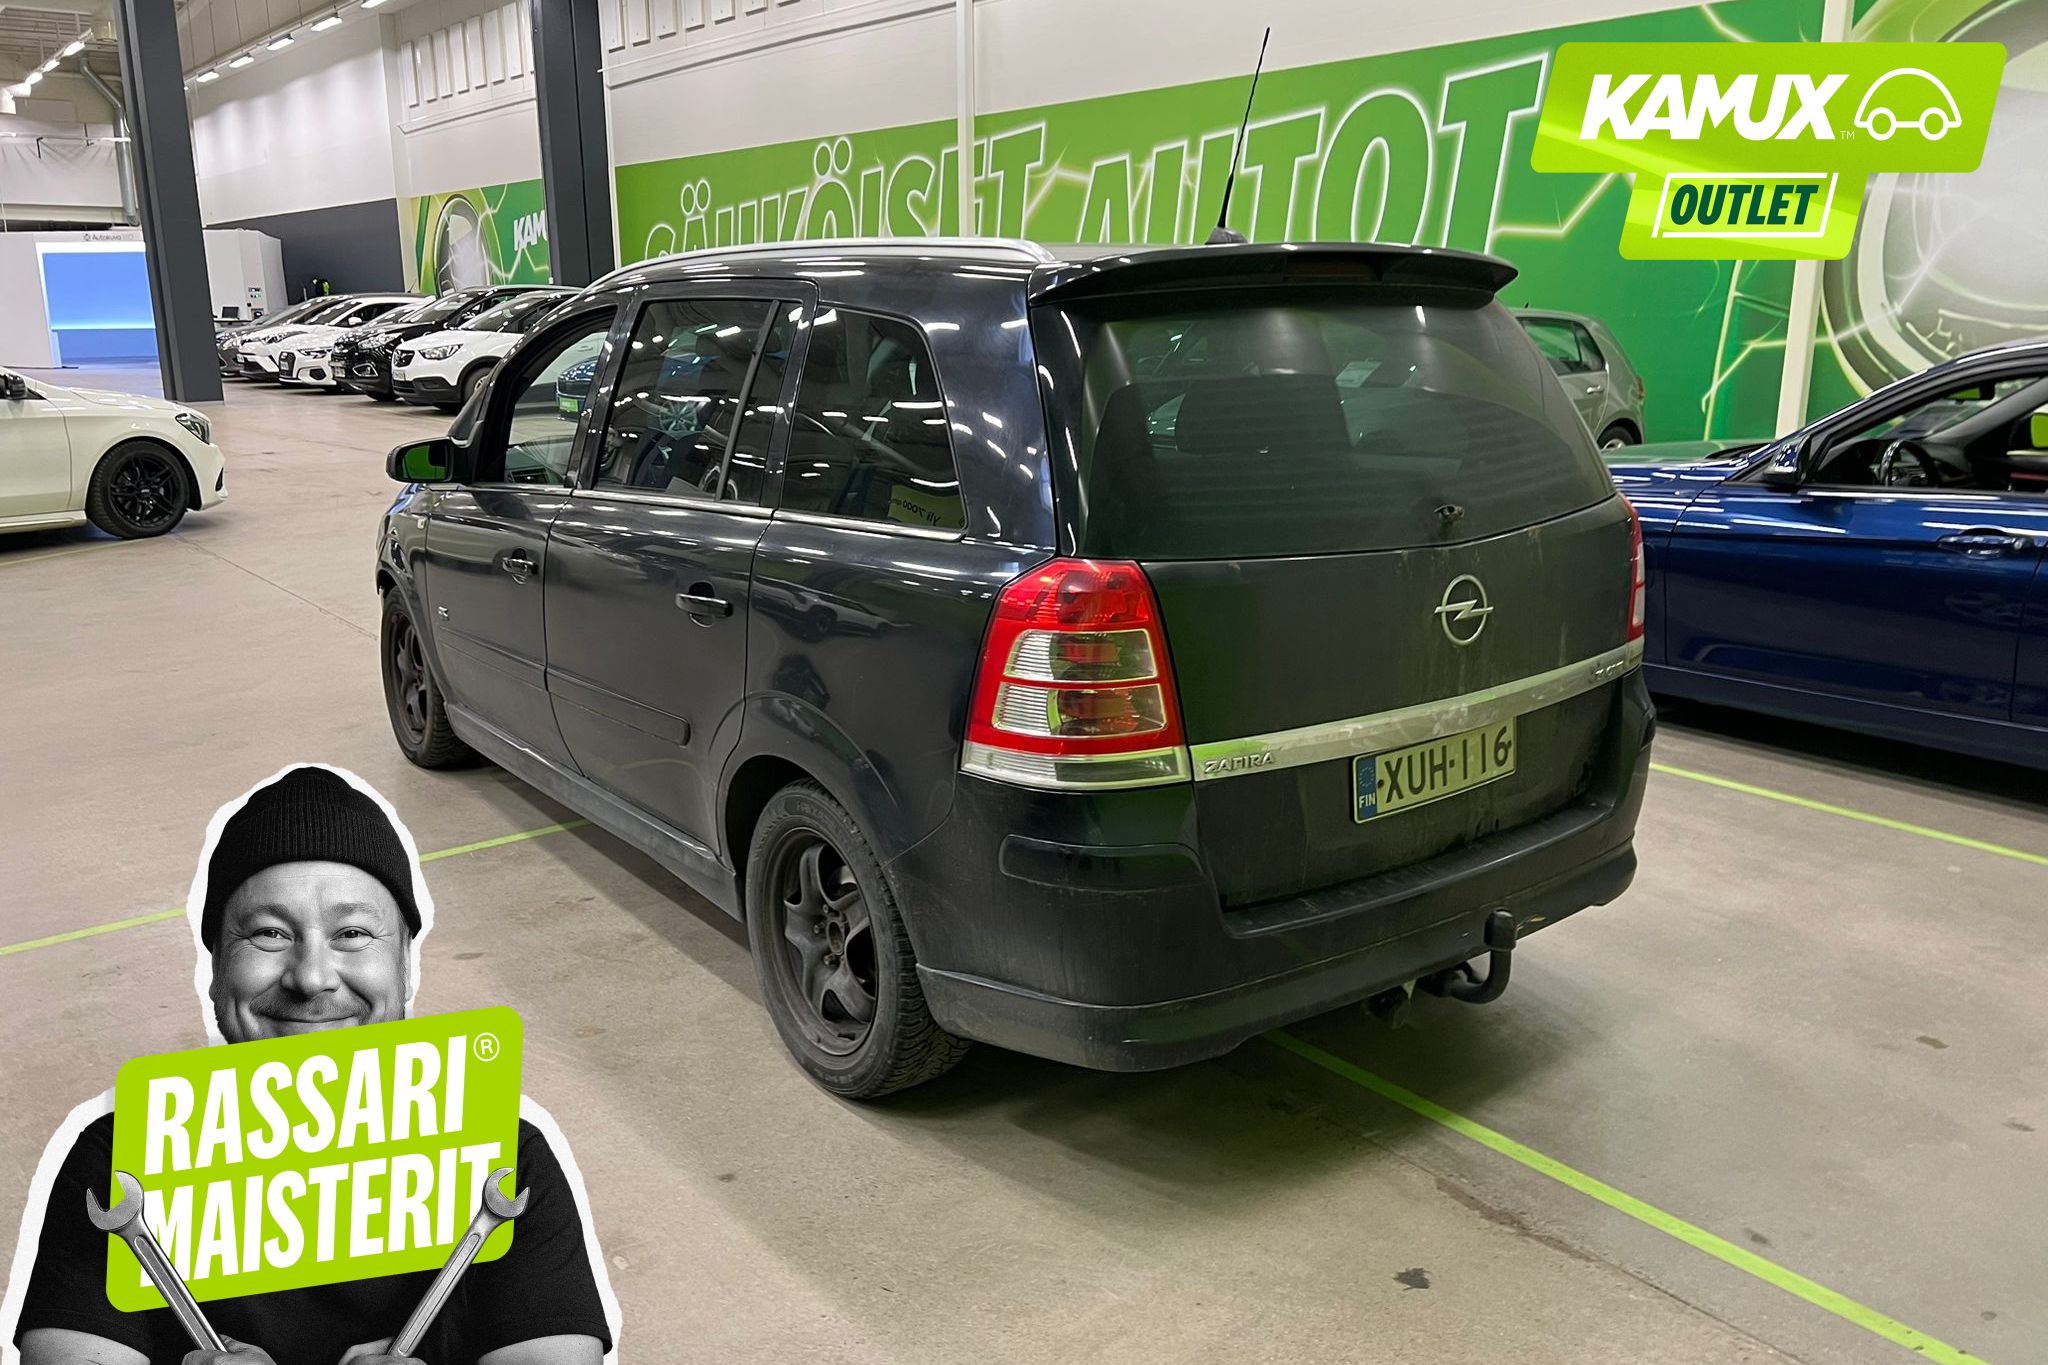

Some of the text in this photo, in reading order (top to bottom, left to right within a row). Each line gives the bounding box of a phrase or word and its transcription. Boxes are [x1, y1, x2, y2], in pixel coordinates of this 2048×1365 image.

[513, 209, 548, 252] KAM
[1204, 751, 1274, 774] ZAFIRA
[1384, 725, 1509, 804] XUH-116
[1358, 792, 1376, 809] FIN
